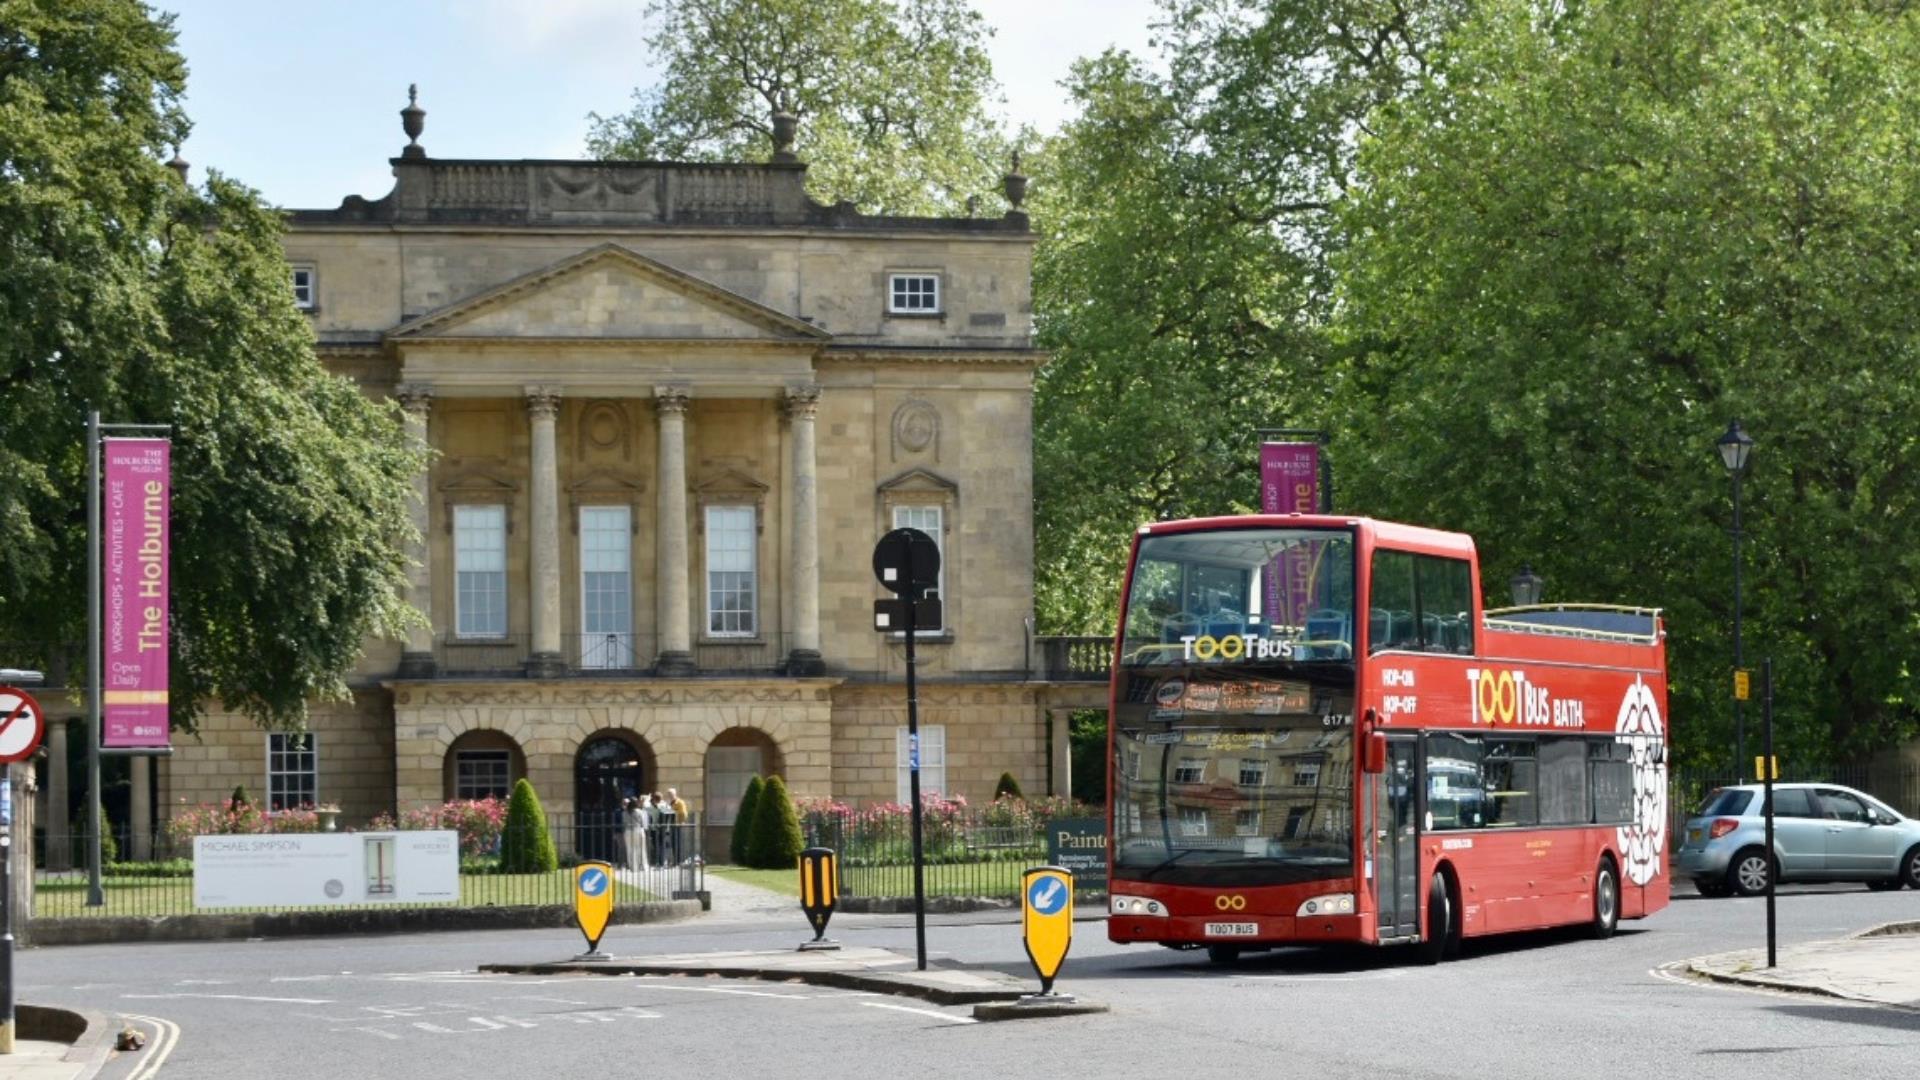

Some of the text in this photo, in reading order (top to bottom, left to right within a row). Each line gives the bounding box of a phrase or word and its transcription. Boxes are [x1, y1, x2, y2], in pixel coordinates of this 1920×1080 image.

[112, 519, 123, 574] ACTIVITIES
[138, 480, 162, 653] The Holburne
[112, 584, 123, 653] WORKSHOPS
[112, 661, 141, 675] Open
[112, 674, 139, 688] Daily
[1382, 669, 1414, 686] HOP-ON
[1383, 696, 1416, 713] HOP-OFF
[1323, 714, 1342, 725] 617
[201, 840, 301, 851] MICHAEL SIMPSON
[1235, 925, 1254, 934] BUS
